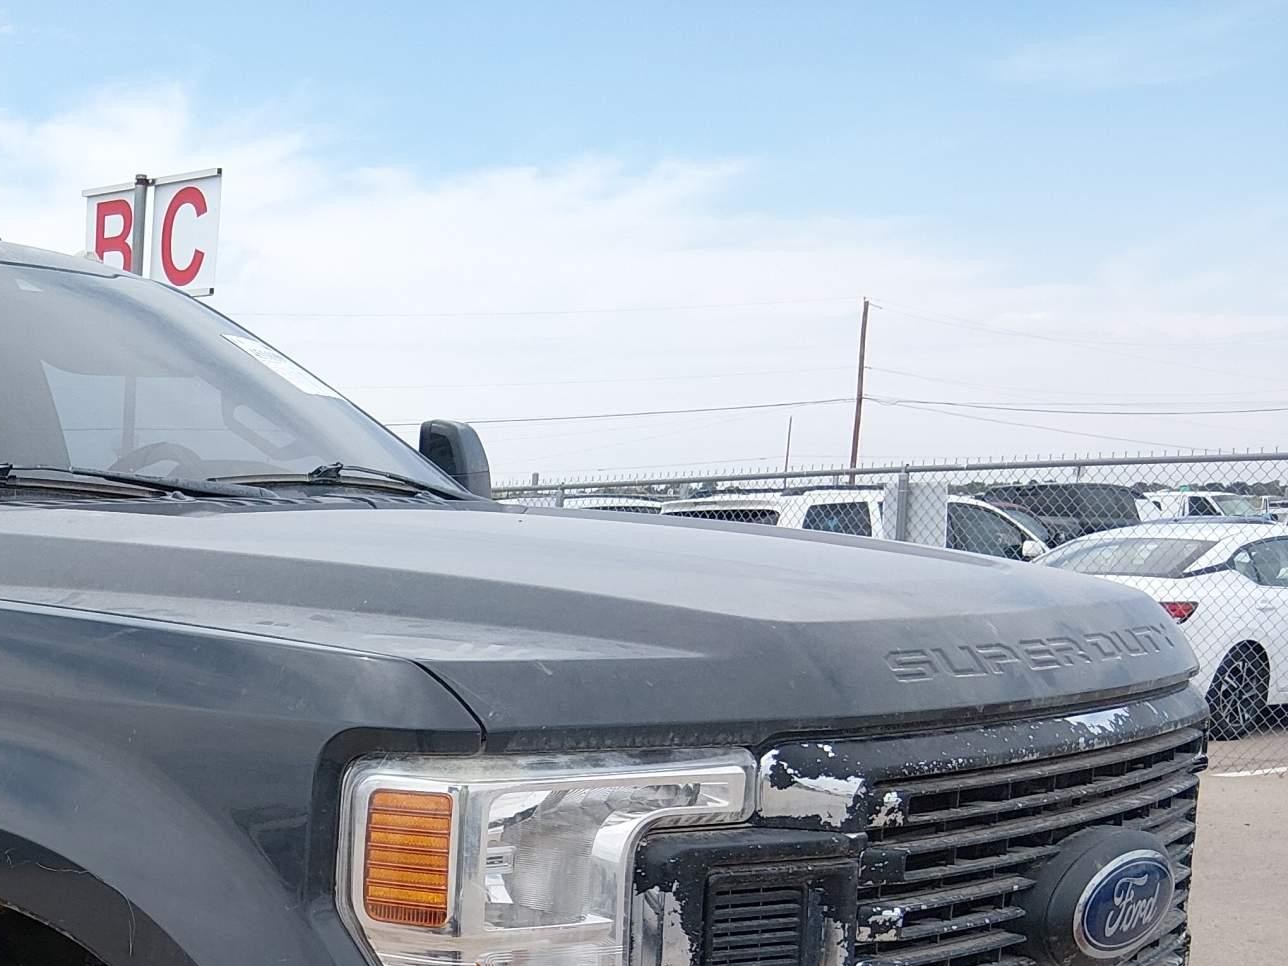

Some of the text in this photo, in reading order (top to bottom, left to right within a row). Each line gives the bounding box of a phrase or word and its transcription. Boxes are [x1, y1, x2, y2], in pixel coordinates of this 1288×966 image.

[161, 186, 208, 287] C
[883, 622, 1175, 683] SUPER DUTY
[1104, 873, 1161, 938] Ford
